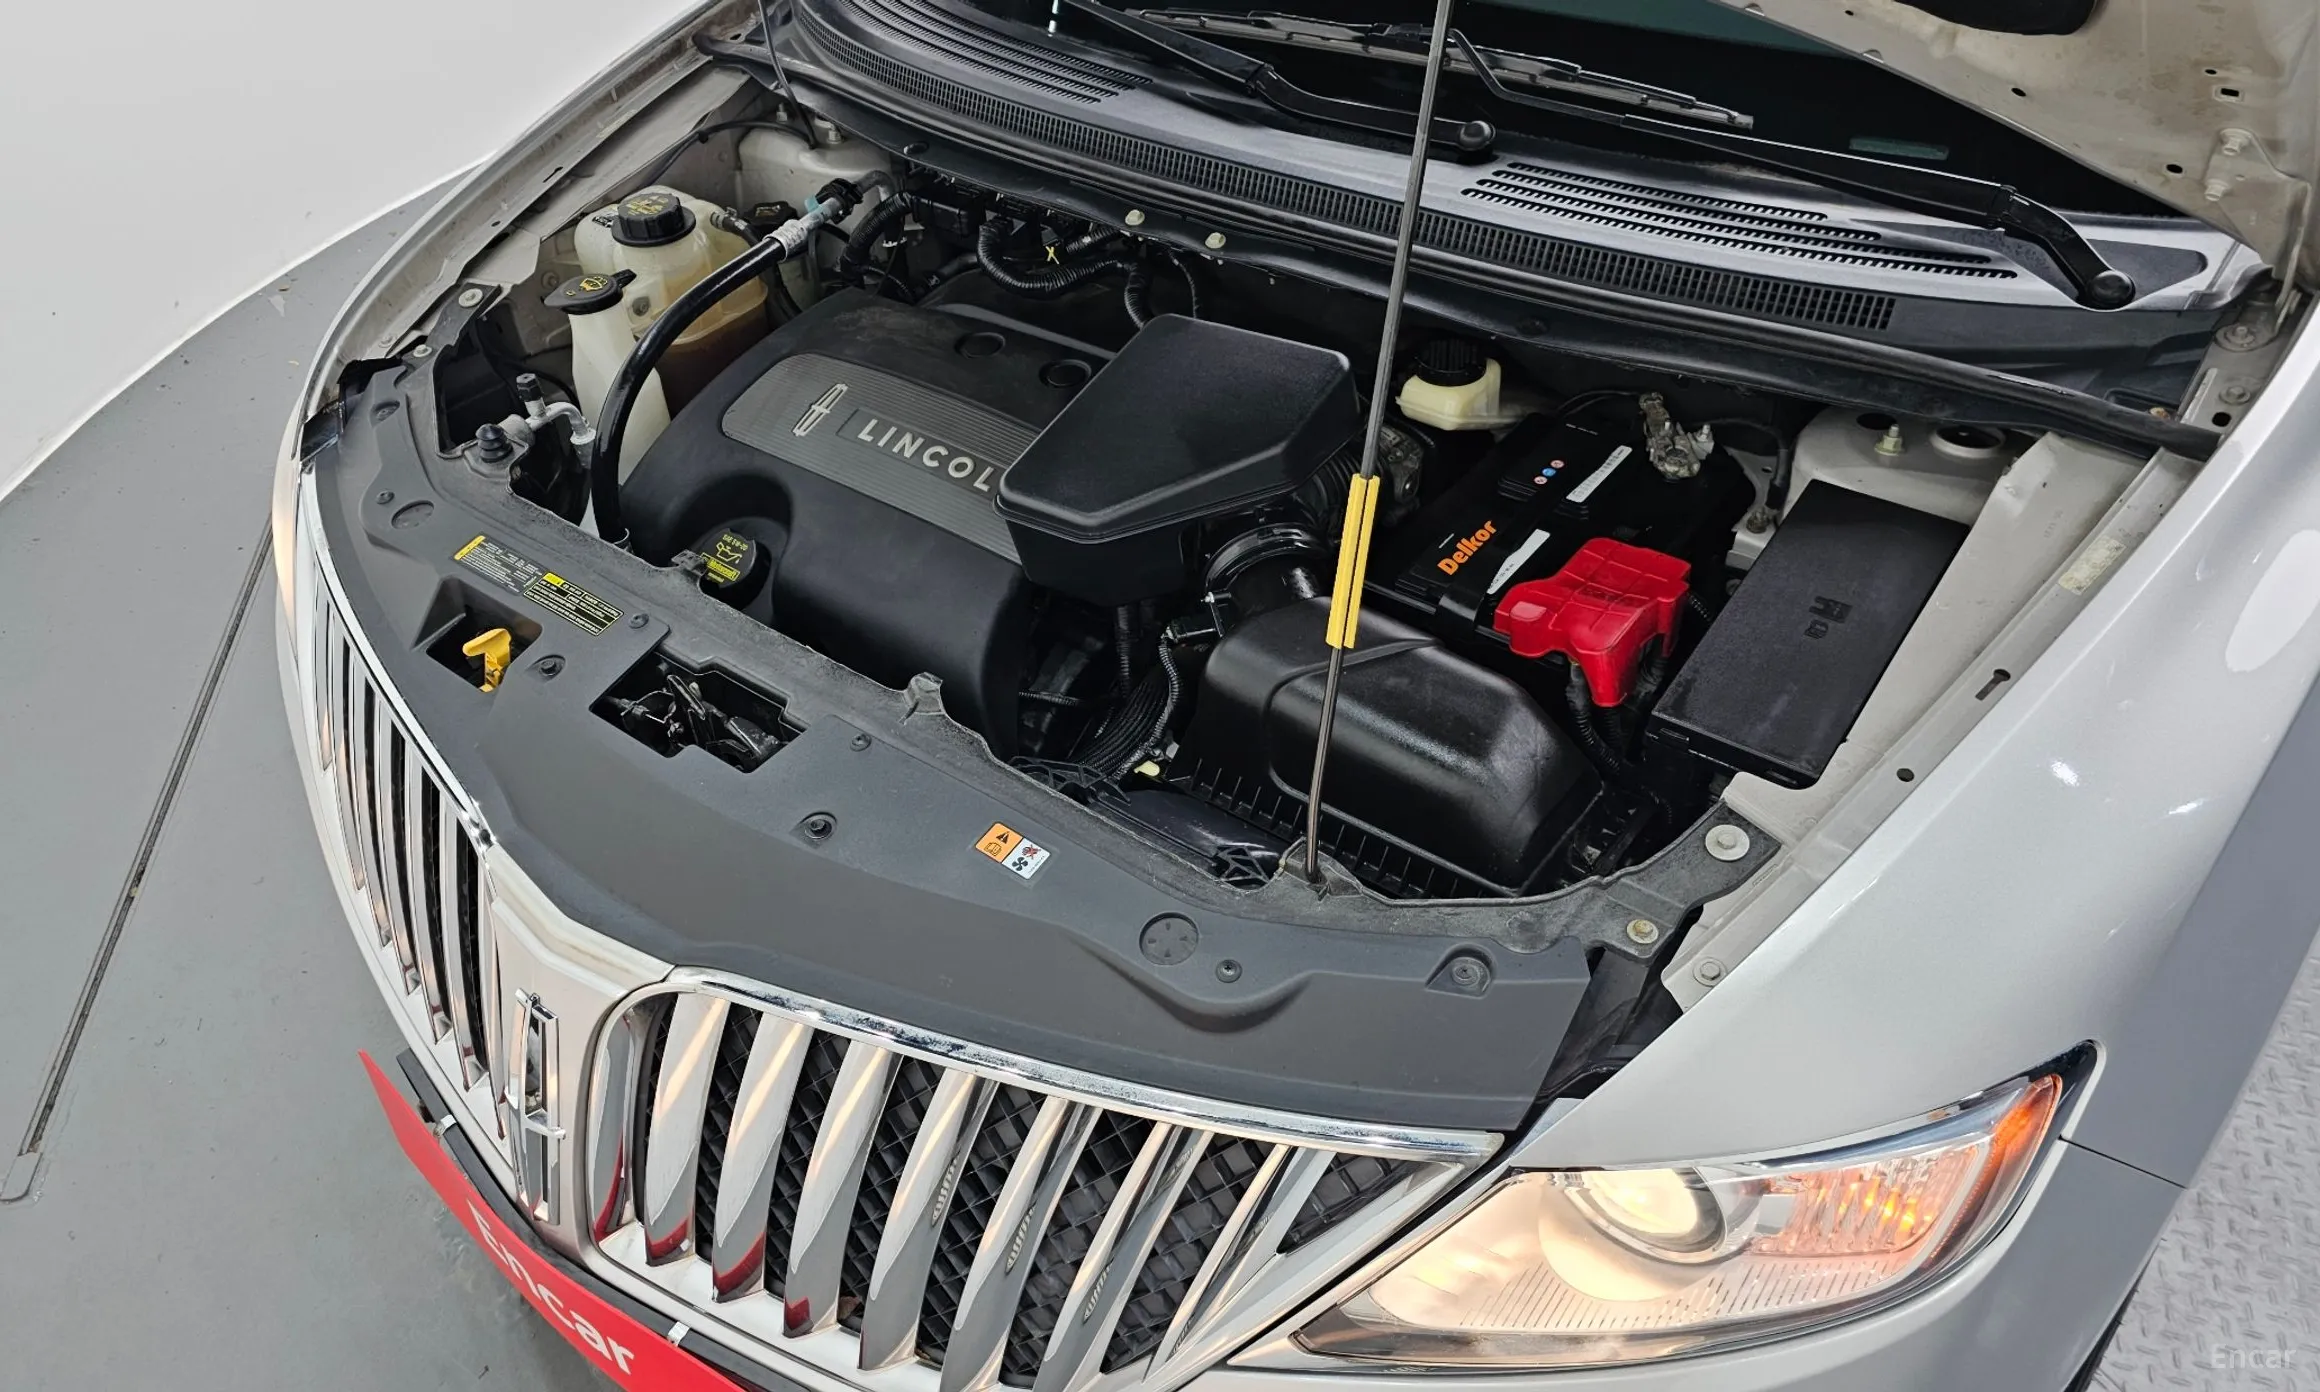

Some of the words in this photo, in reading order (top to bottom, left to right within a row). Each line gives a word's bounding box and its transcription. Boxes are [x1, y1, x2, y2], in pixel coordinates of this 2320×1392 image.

[858, 417, 994, 492] LINCOL
[1437, 520, 1497, 575] Delkor
[466, 1198, 635, 1375] Encar
